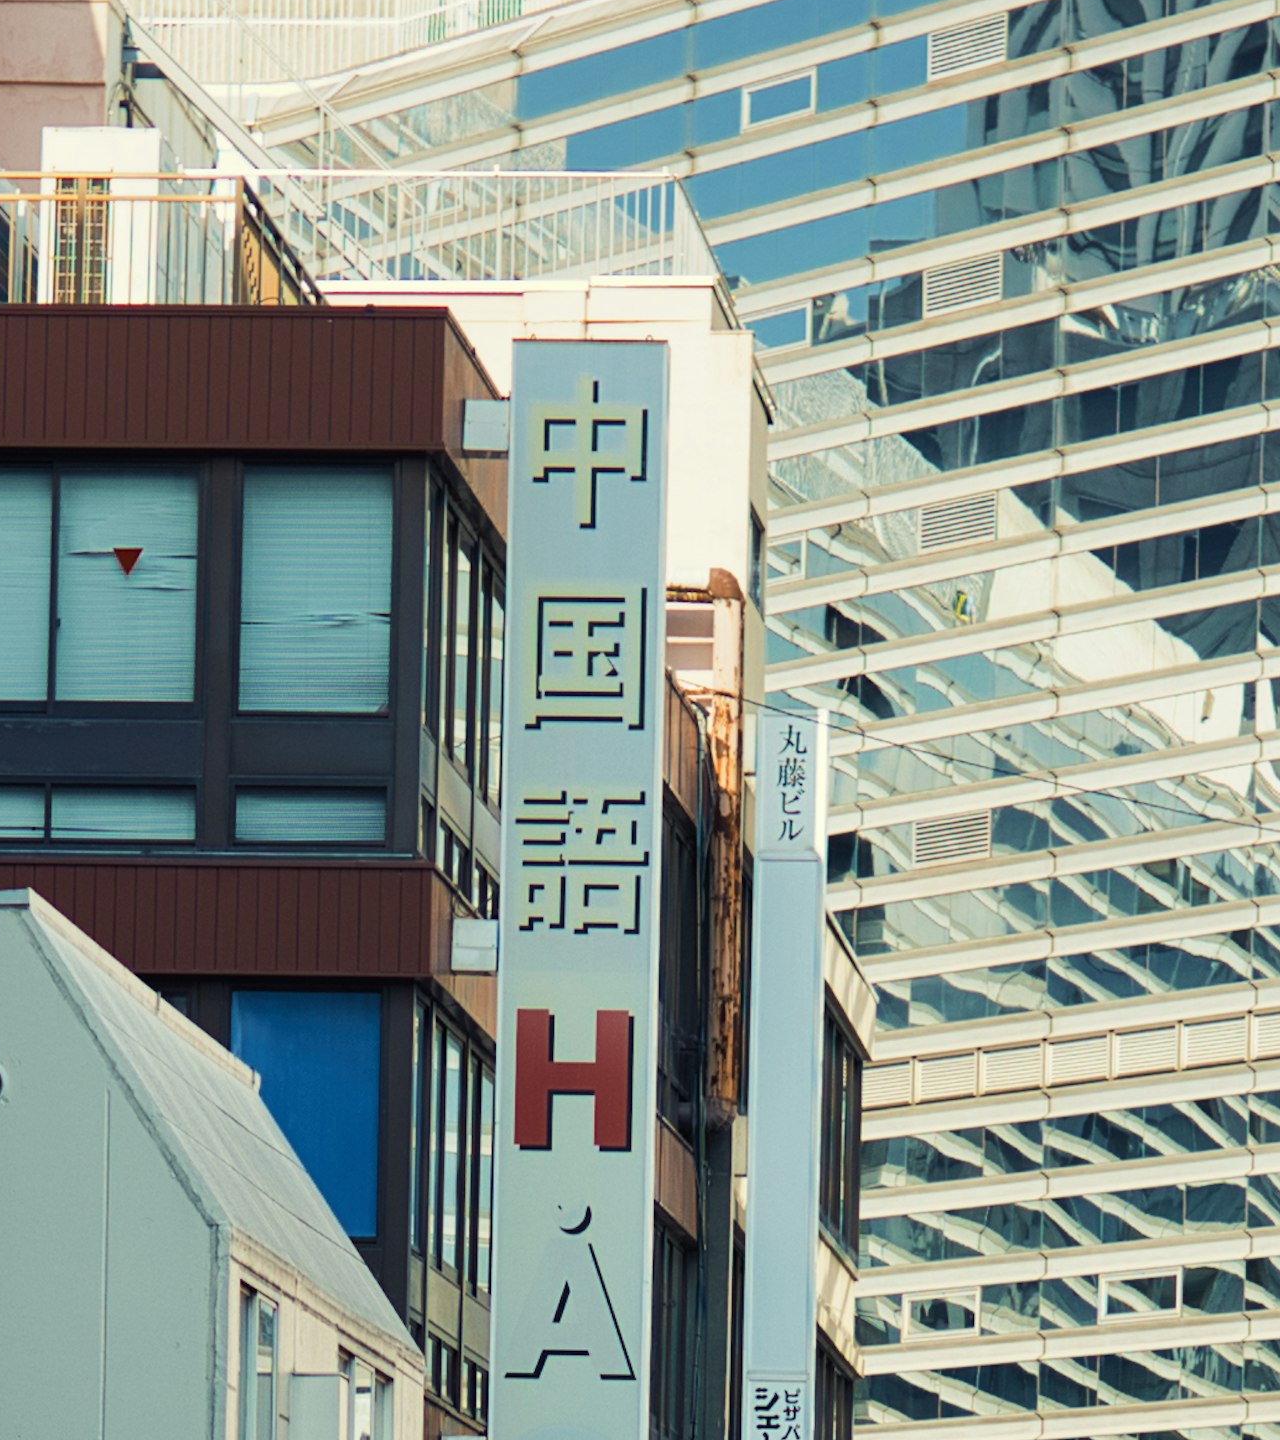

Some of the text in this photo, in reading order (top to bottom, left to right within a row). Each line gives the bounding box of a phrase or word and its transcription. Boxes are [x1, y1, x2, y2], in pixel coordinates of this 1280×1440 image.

[517, 372, 650, 934] 中国語
[777, 724, 807, 843] 丸藤ビル
